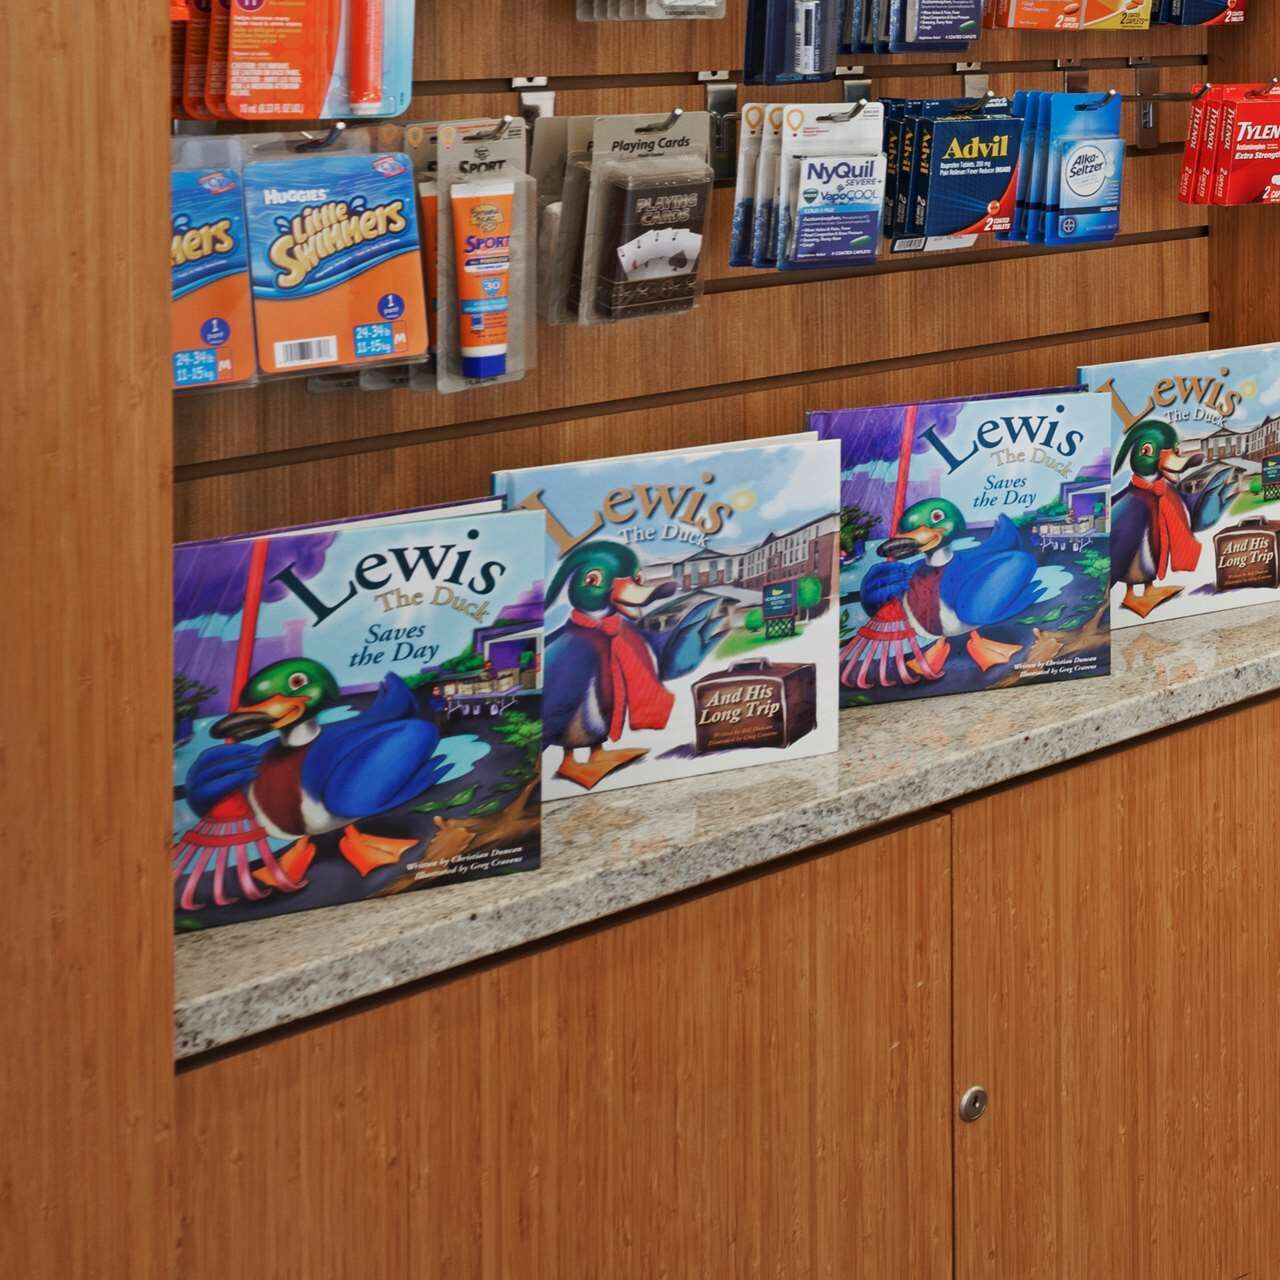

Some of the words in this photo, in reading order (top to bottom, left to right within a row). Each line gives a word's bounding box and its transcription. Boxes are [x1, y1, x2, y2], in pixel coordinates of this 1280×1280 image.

[611, 138, 655, 152] Playing
[657, 136, 690, 149] Cards
[942, 135, 1009, 160] Advil
[1234, 152, 1254, 160] Extra
[807, 160, 875, 184] NyQuil
[1069, 162, 1104, 178] Seltzer
[1074, 153, 1099, 167] Alka-
[263, 188, 328, 205] HUGGIES
[292, 200, 349, 241] Little
[464, 235, 511, 254] SPORT
[1094, 366, 1243, 434] Lewis
[918, 404, 1084, 475] Lewis
[983, 472, 1028, 492] Saves
[972, 491, 1000, 507] the
[1003, 489, 1037, 509] Day
[521, 471, 732, 557] Lewis
[618, 524, 656, 545] The
[659, 522, 710, 549] Duck
[1222, 538, 1246, 556] And
[1248, 536, 1270, 553] His
[1218, 552, 1247, 569] Long
[1247, 547, 1275, 566] Trip
[269, 529, 506, 628] Lewis
[374, 590, 424, 613] The
[430, 585, 492, 623] Duck
[366, 622, 426, 645] Saves
[348, 645, 389, 668] the
[392, 640, 439, 670] Day
[705, 686, 742, 708] And
[744, 684, 774, 702] His
[698, 706, 742, 725] Long
[745, 700, 780, 718] Trip
